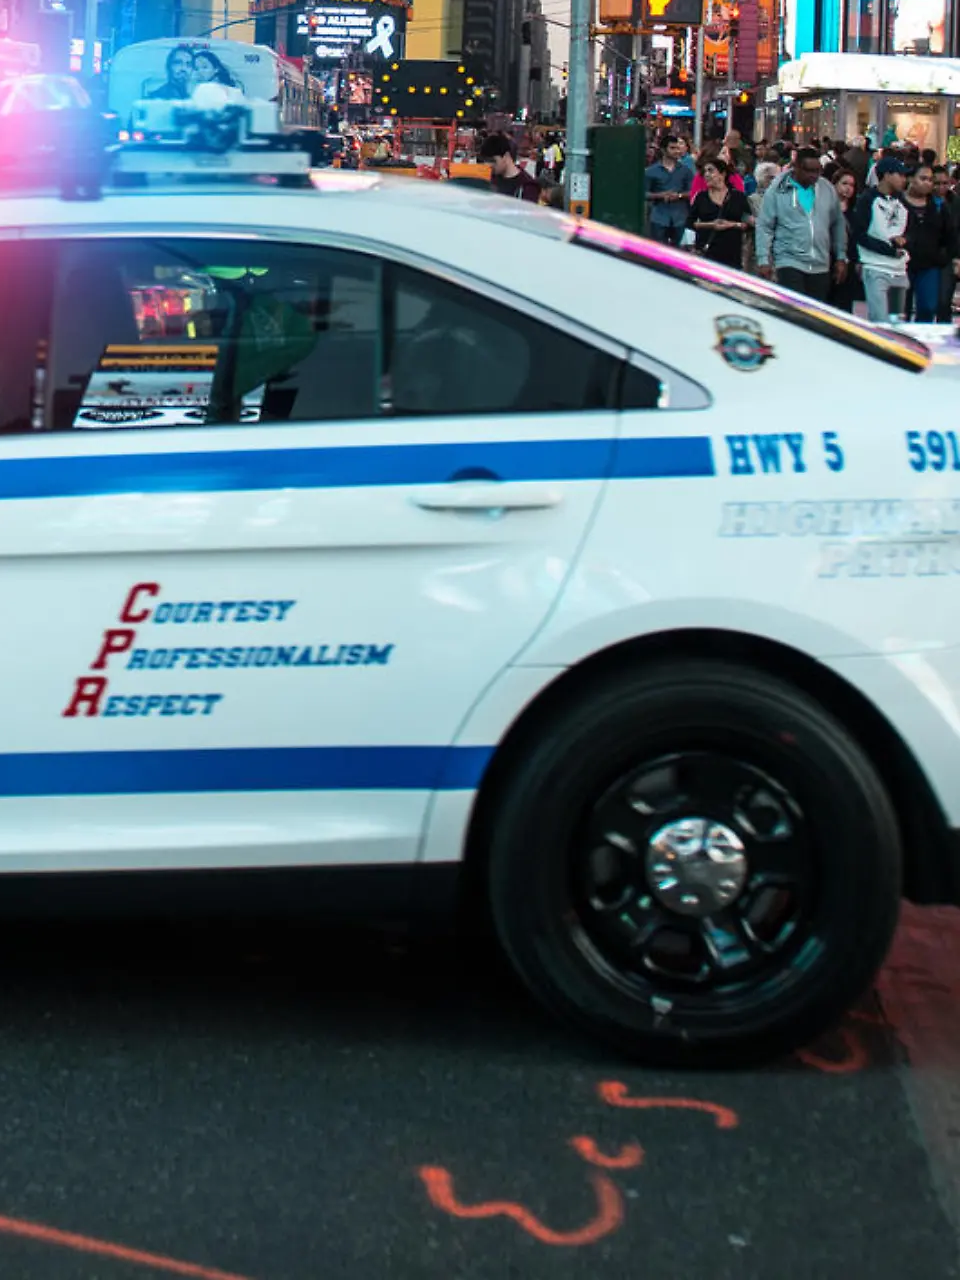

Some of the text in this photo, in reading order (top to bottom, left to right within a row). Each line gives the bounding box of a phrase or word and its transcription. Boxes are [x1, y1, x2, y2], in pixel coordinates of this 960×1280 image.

[724, 432, 807, 475] HWY
[821, 431, 846, 472] 5
[118, 582, 297, 624] COURTESY
[90, 629, 395, 670] PROFESSIONALISM
[62, 676, 223, 718] RESPECT
